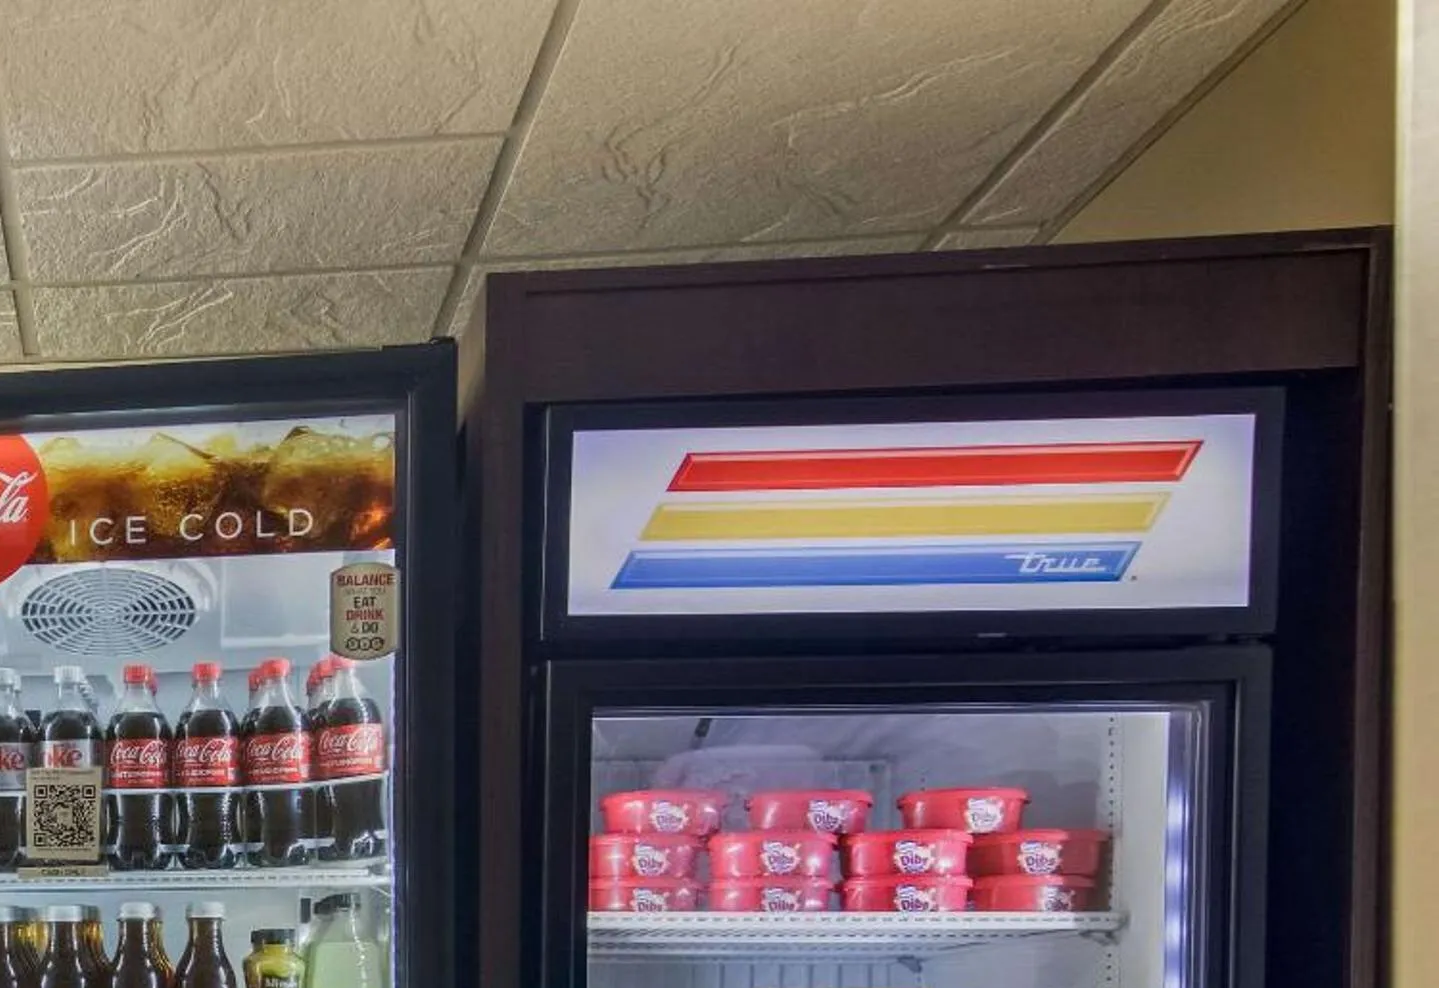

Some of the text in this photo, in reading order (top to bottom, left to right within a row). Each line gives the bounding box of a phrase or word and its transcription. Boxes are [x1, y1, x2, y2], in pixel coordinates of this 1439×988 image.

[69, 507, 315, 547] ICE COLD
[337, 573, 394, 586] BALANCE
[353, 596, 376, 608] EAT
[345, 609, 384, 620] DRINK
[361, 621, 378, 633] DO
[900, 854, 928, 868] Dibs
[1026, 855, 1055, 868] Dibs
[901, 899, 929, 911] Dibs
